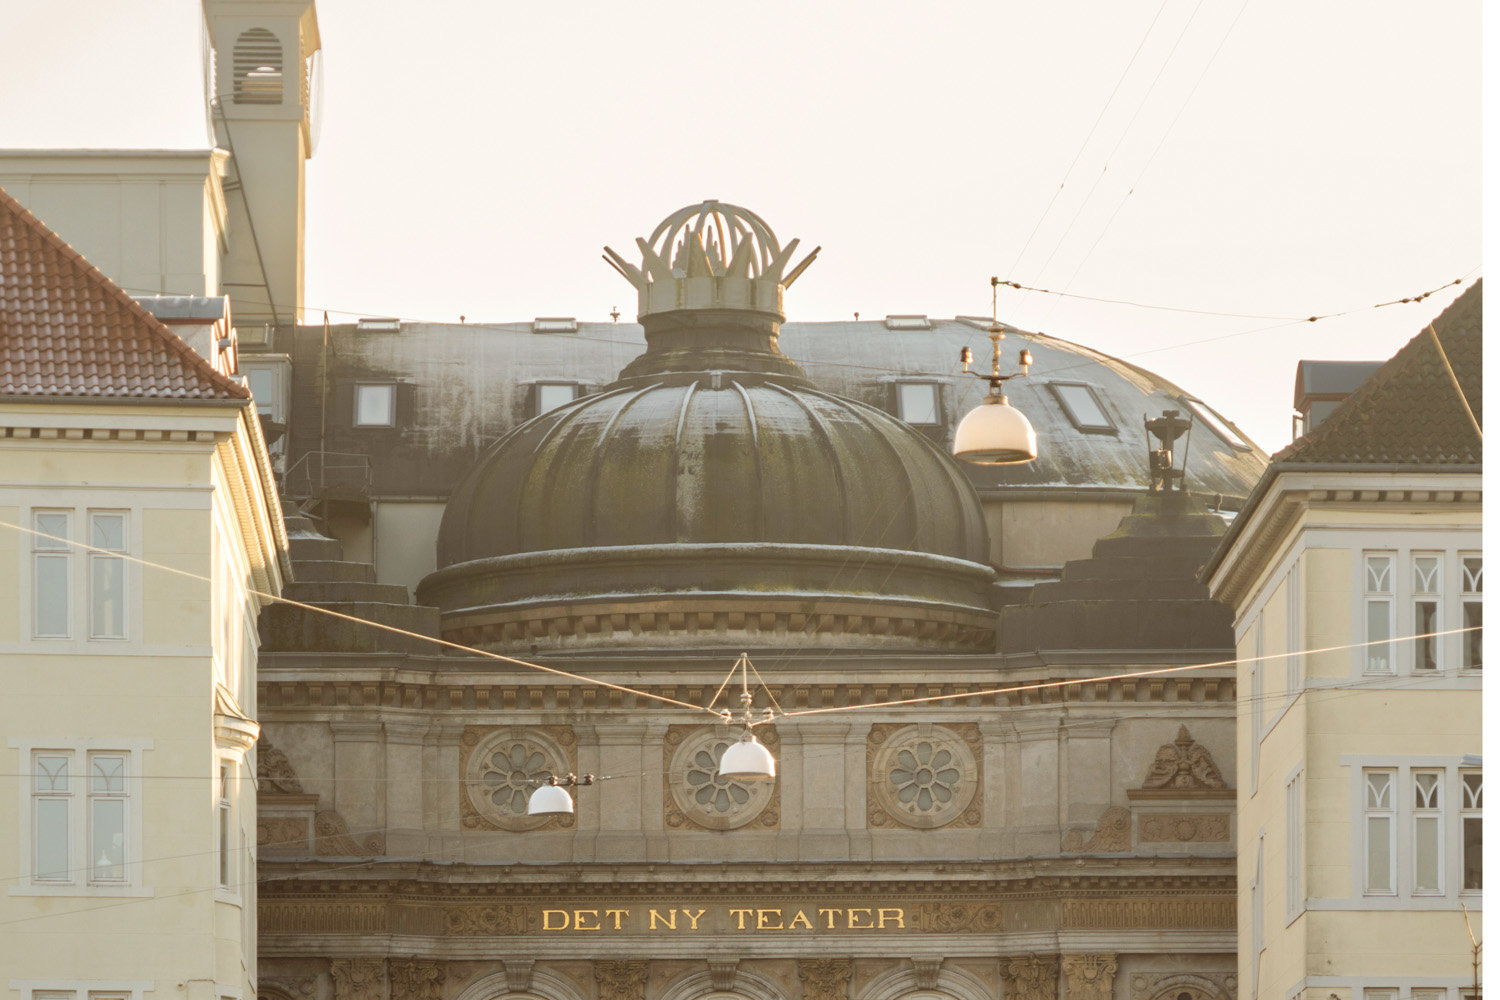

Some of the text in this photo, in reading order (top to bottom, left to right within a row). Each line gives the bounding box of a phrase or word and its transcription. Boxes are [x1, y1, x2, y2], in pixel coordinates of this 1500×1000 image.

[541, 907, 906, 931] DET NY TEATER
